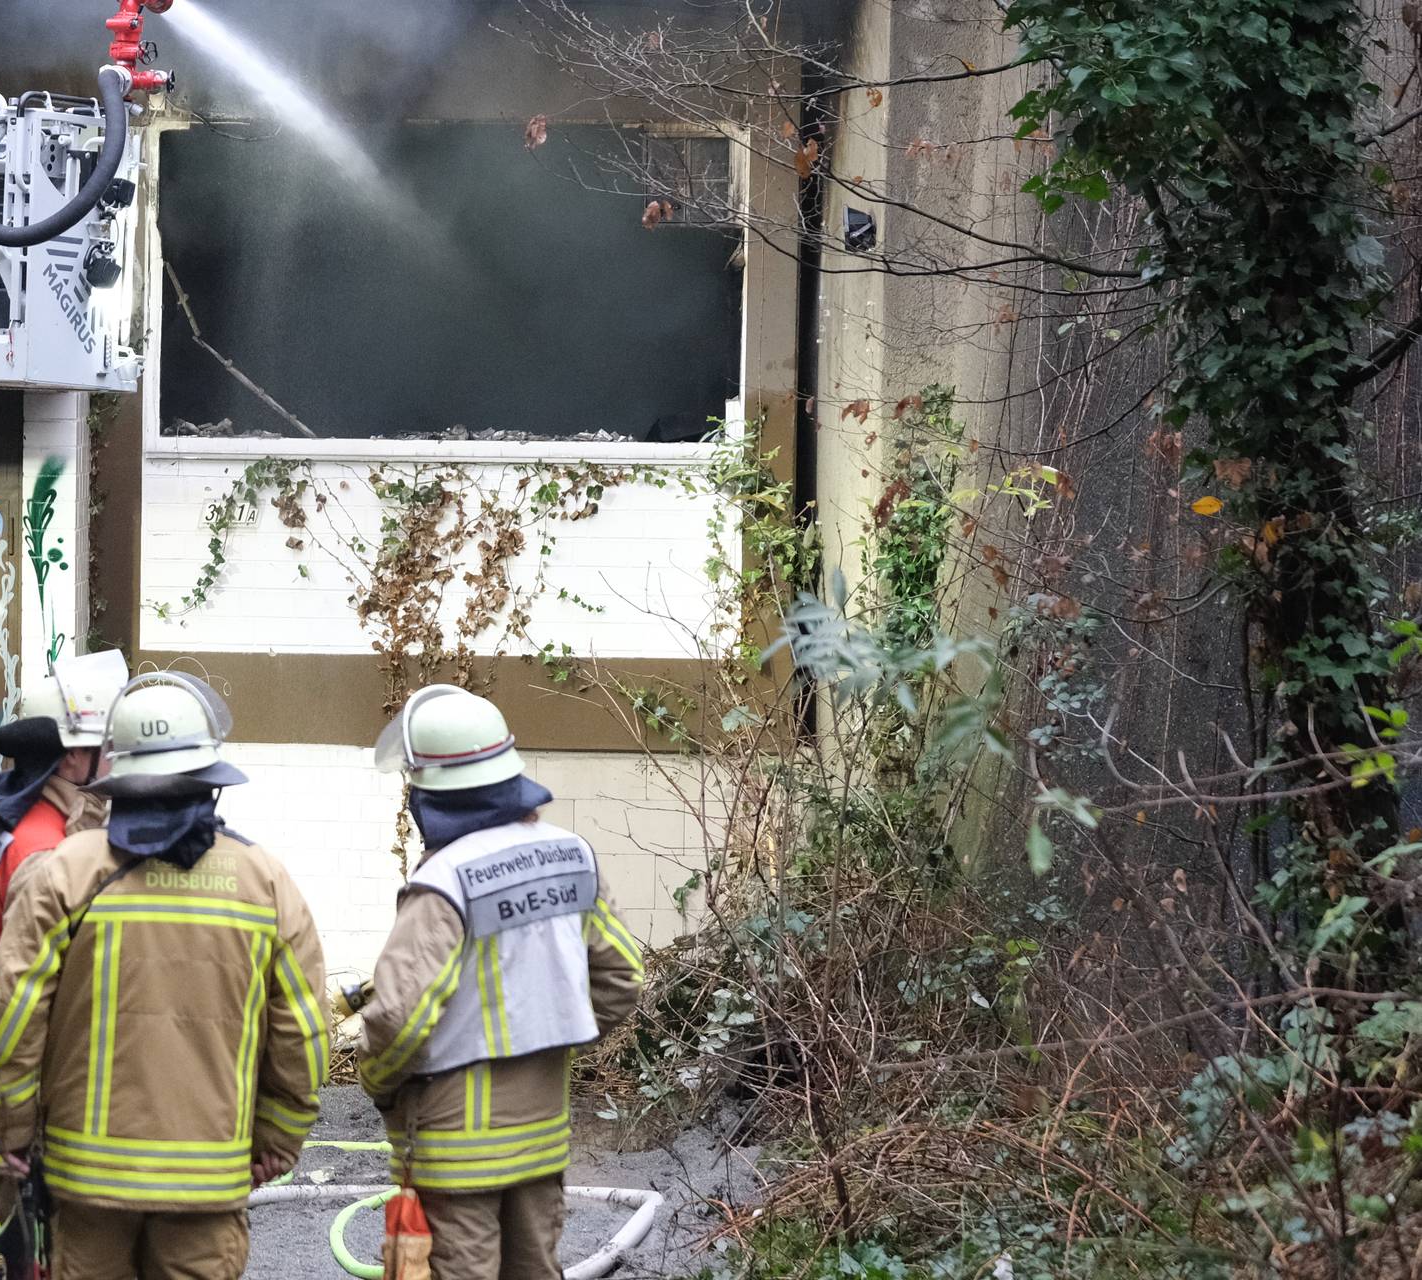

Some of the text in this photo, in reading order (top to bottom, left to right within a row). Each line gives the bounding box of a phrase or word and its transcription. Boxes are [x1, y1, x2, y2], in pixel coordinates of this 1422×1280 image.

[43, 263, 96, 354] MAGIRUS
[141, 720, 169, 737] UD
[145, 871, 238, 893] DUISBURG
[465, 845, 583, 887] Feuerwehr Duisburg
[497, 883, 578, 920] BvE-Süd
